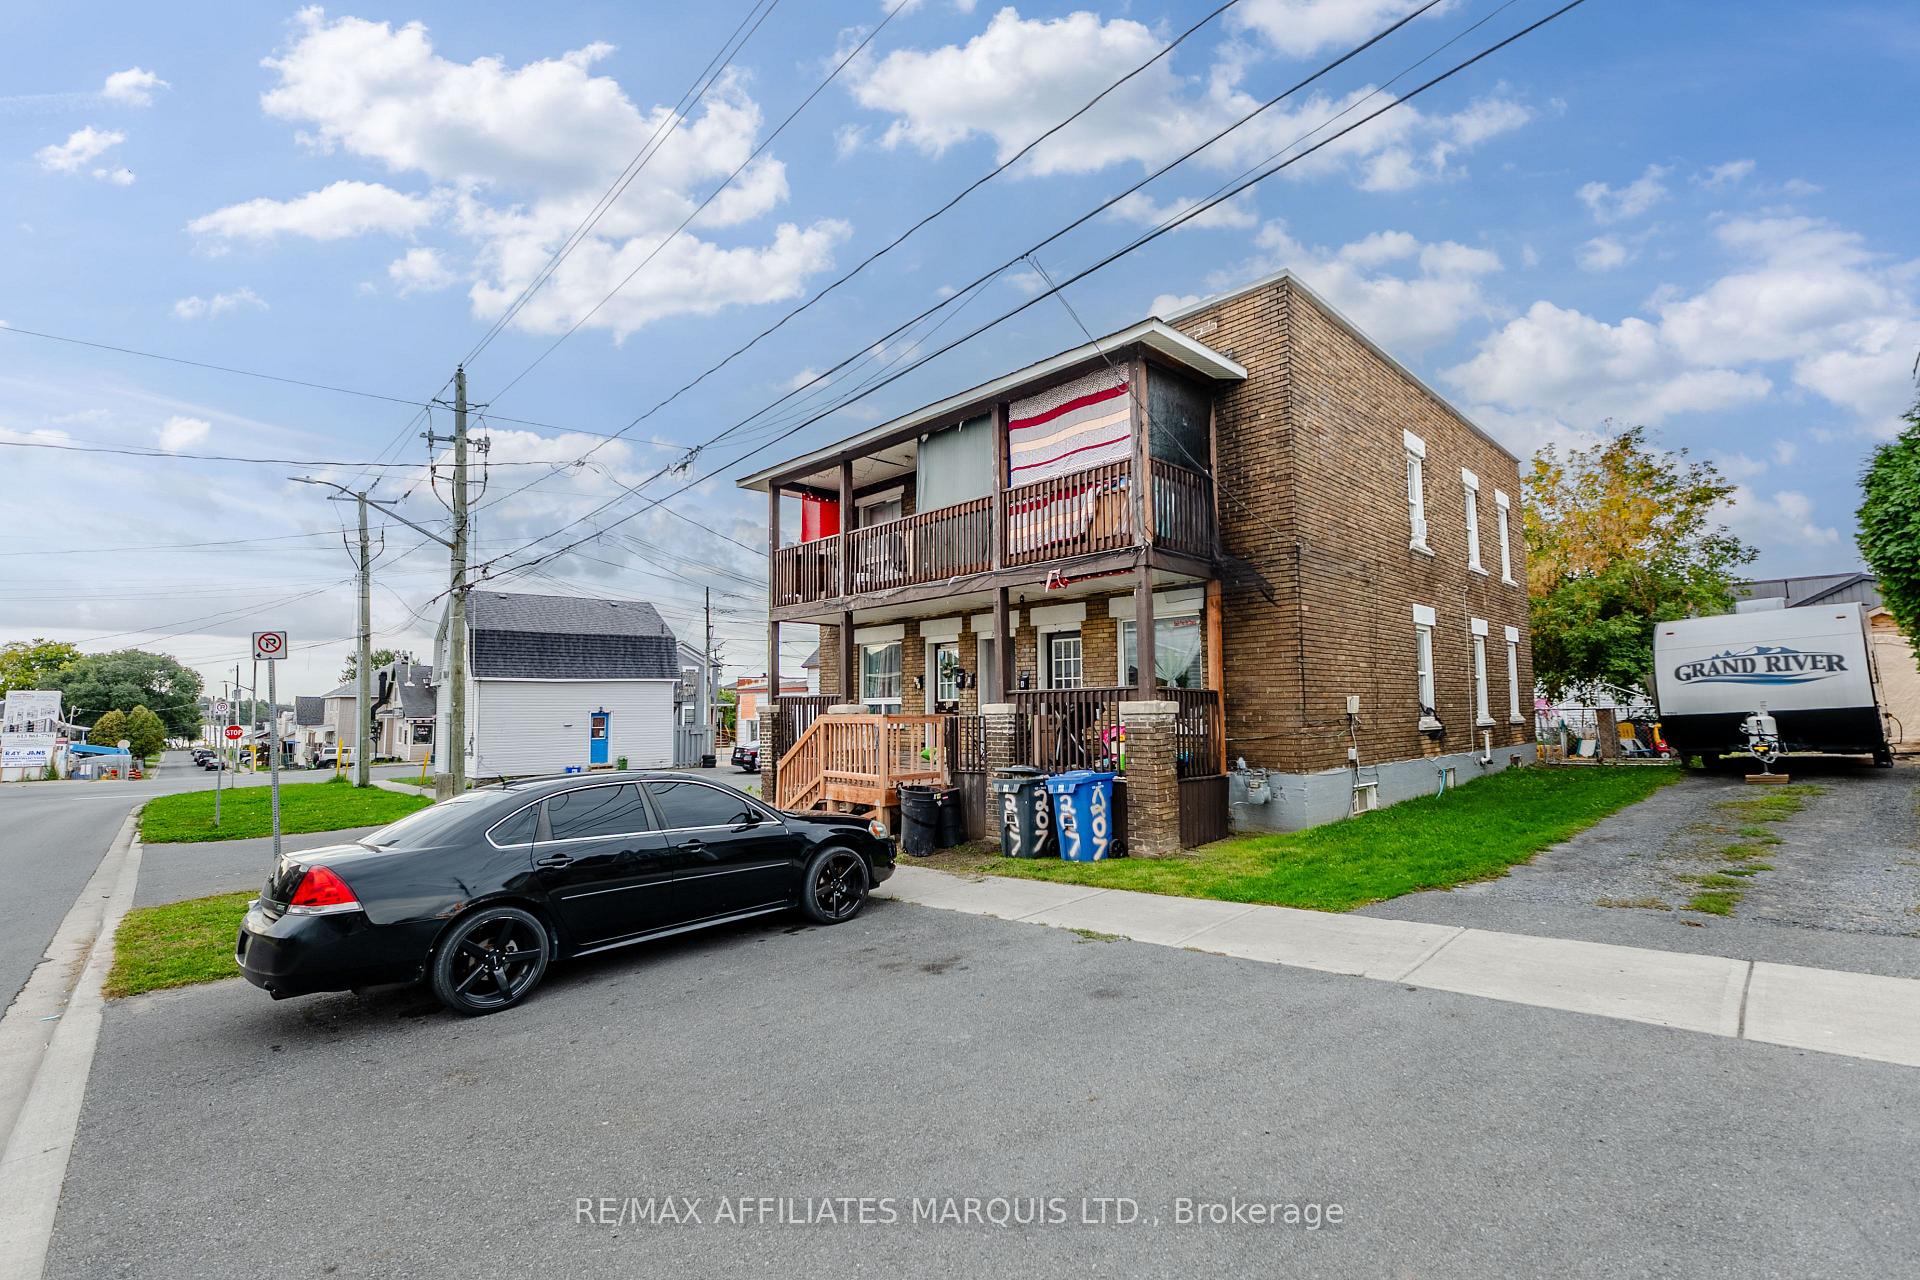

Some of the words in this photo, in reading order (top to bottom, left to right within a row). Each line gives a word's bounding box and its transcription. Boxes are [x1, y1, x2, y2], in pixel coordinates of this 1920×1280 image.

[1674, 657, 1757, 682] GRAND
[1763, 654, 1848, 673] RIVER
[1033, 789, 1050, 853] 207
[1060, 794, 1081, 858] 207
